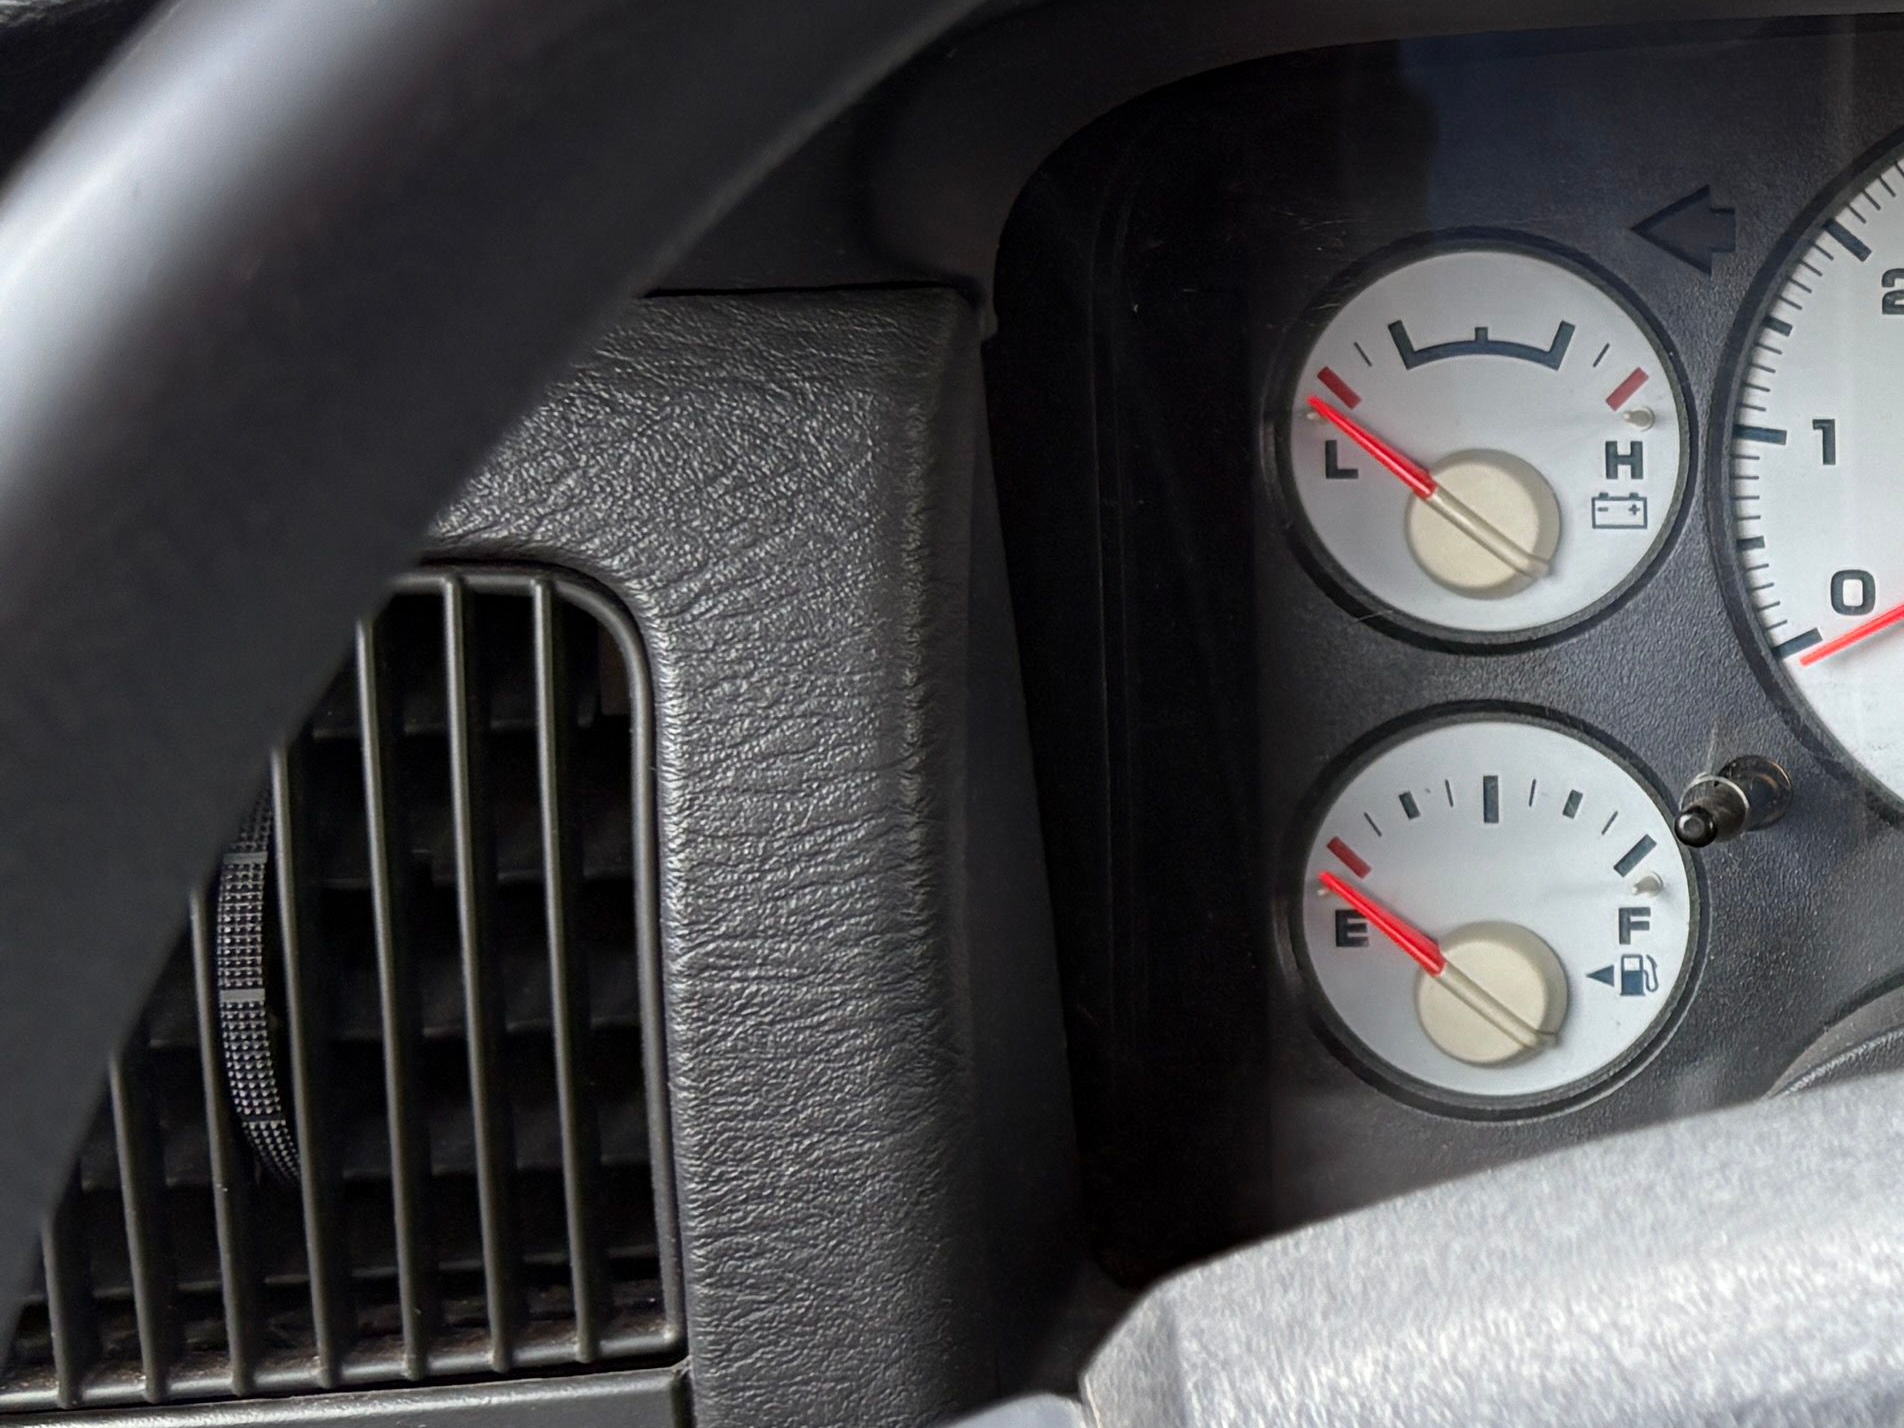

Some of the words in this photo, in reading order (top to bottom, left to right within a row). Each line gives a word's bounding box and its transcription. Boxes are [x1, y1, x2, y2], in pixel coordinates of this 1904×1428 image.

[1325, 439, 1359, 479] L
[1604, 440, 1644, 480] H
[1812, 418, 1837, 465] 1
[1830, 569, 1876, 616] 0
[1335, 908, 1369, 947] E
[1618, 907, 1651, 945] F
